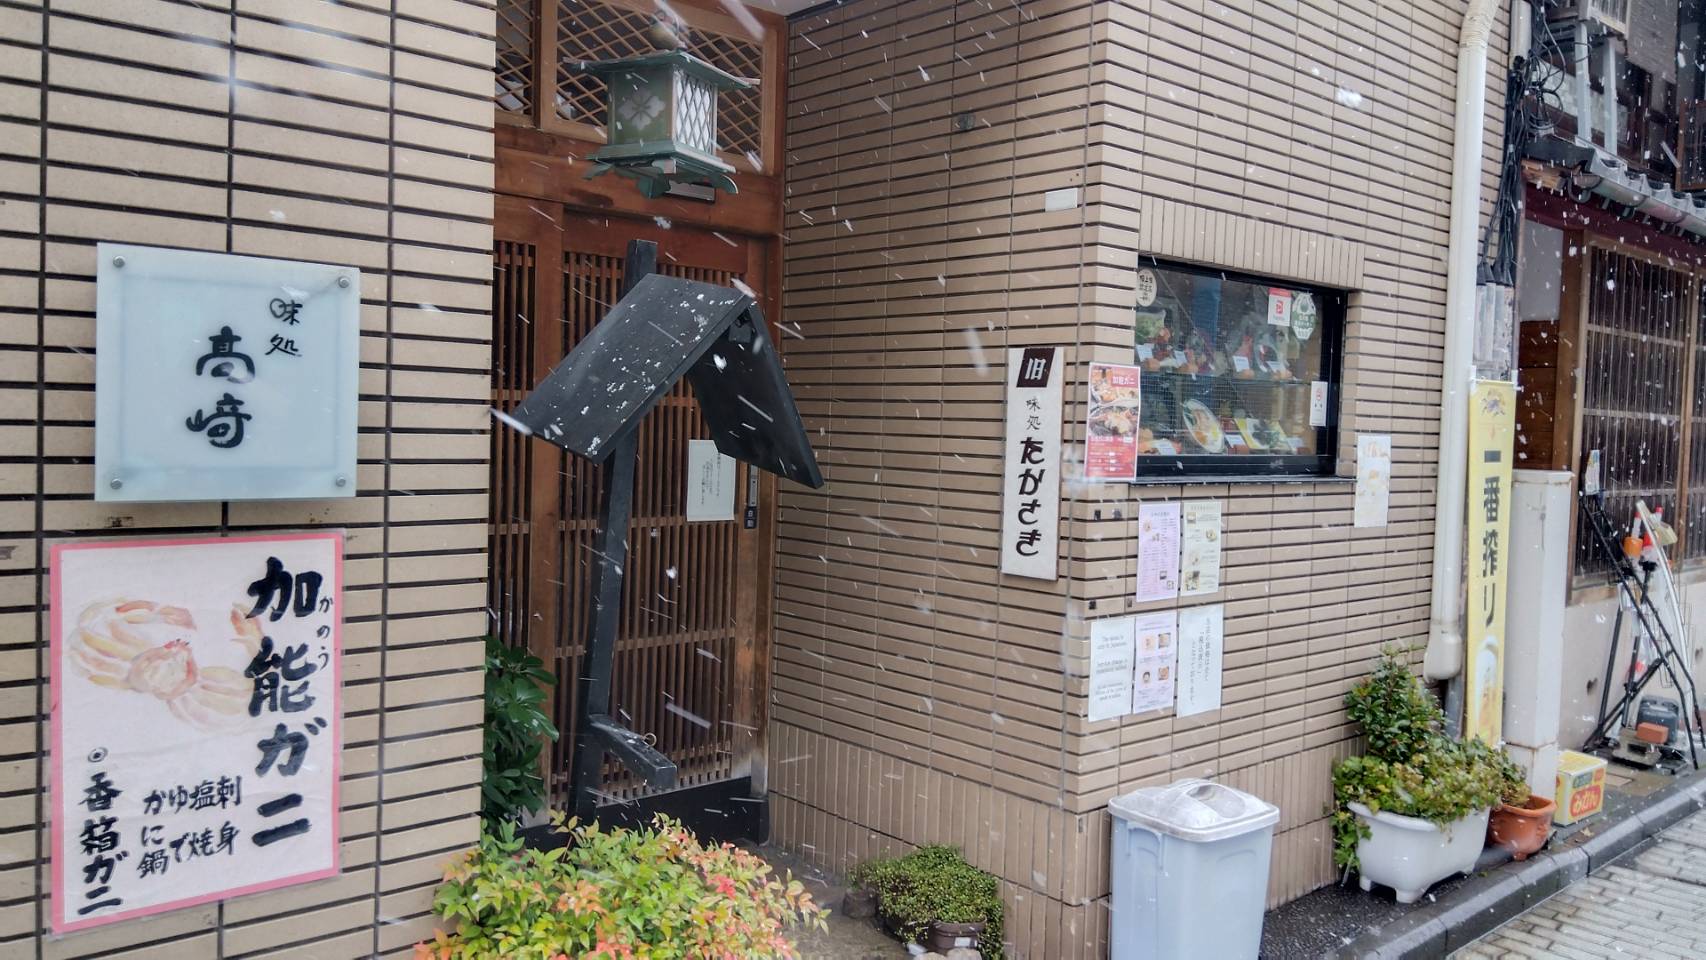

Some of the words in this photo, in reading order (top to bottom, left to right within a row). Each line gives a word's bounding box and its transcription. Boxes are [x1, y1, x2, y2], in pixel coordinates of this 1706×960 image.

[264, 297, 303, 358] 味処
[1024, 357, 1047, 381] 旧
[1025, 396, 1041, 431] 味処
[1015, 436, 1046, 557] たがさき
[1482, 449, 1502, 628] 一番搾り
[316, 598, 334, 672] かのう
